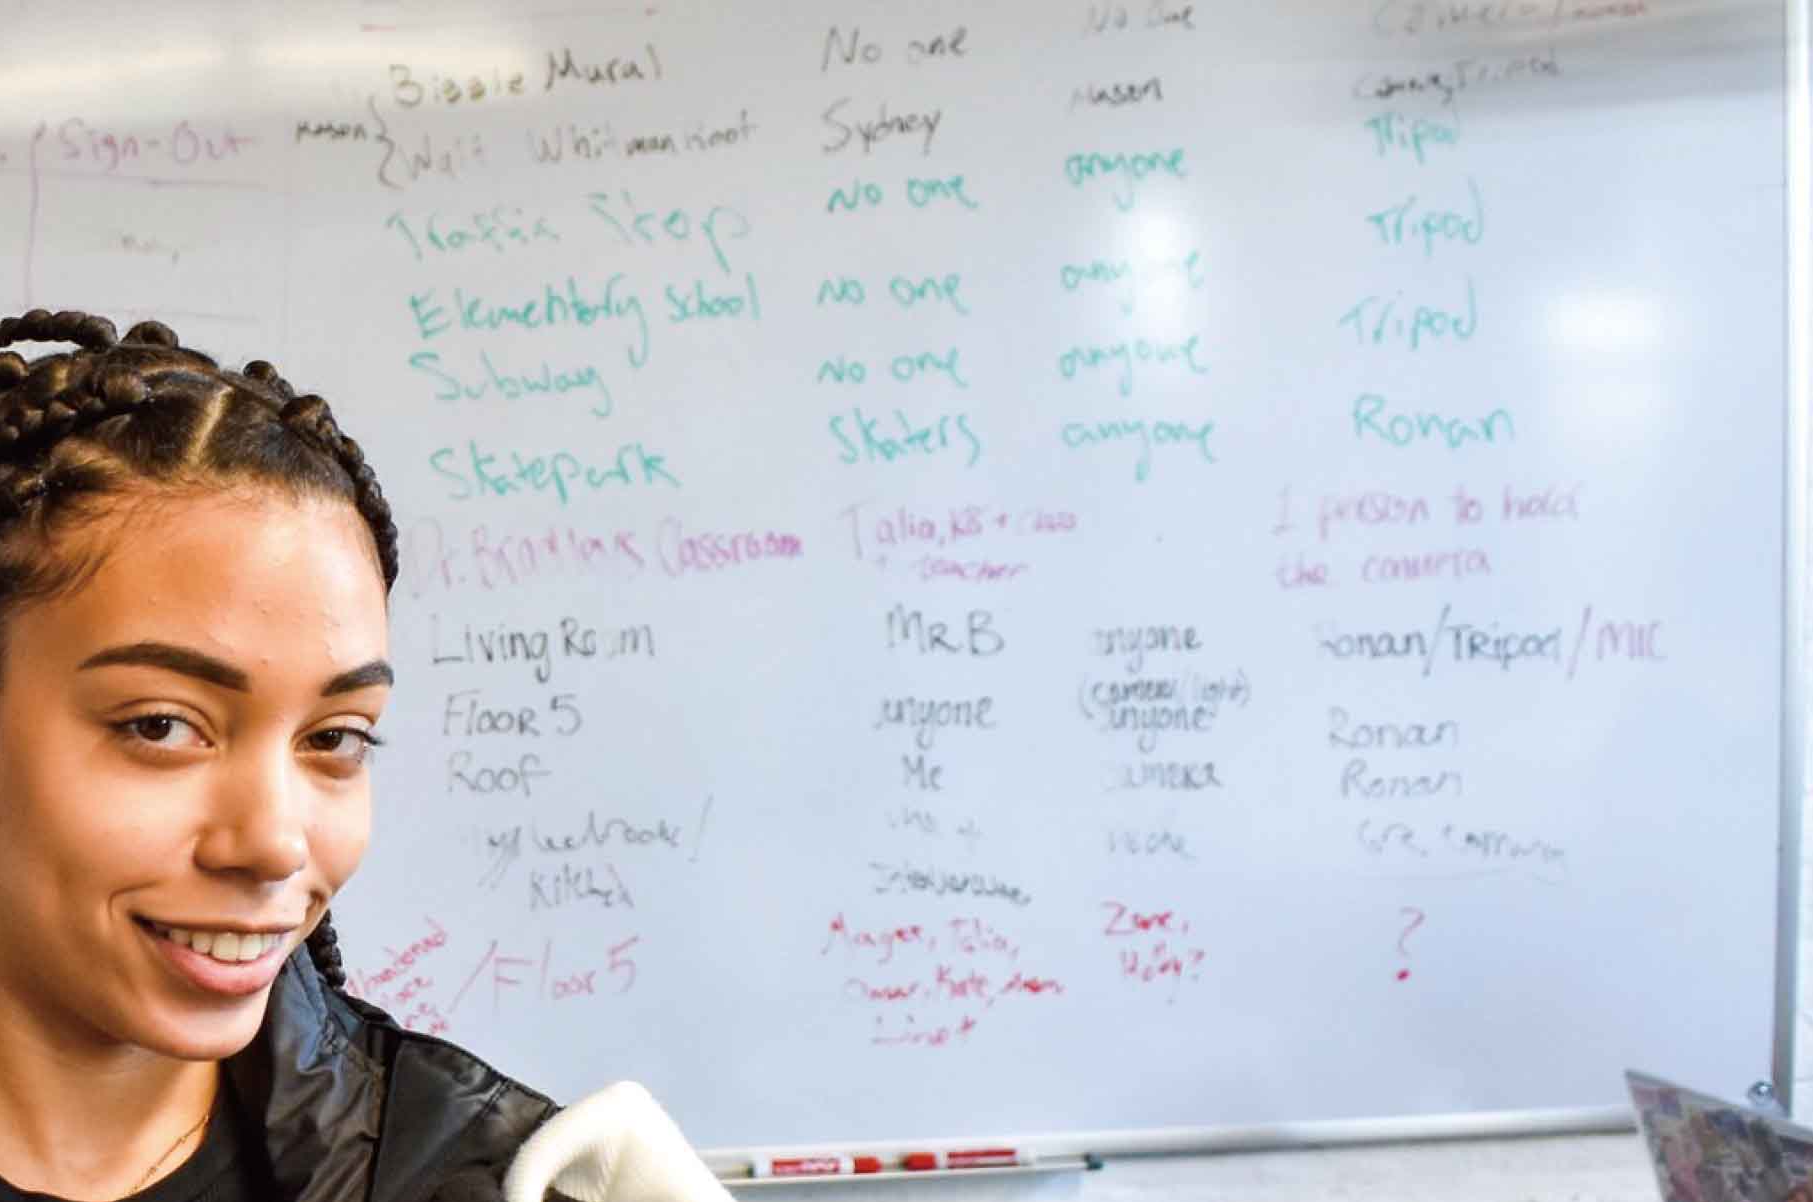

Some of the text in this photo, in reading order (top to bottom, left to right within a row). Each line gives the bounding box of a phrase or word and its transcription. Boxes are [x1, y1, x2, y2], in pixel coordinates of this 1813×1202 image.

[821, 26, 969, 71] No one
[822, 98, 943, 155] Sydney
[826, 174, 979, 213] No one
[1064, 148, 1188, 212] anyone
[1367, 176, 1485, 258] Tripod
[817, 273, 970, 316] No one
[1338, 272, 1479, 352] Tripod
[408, 351, 613, 418] Subway
[817, 347, 970, 390] No one
[829, 406, 982, 468] Skaters
[1352, 391, 1516, 451] Ronan
[1060, 418, 1217, 483] anyone
[550, 693, 583, 737] 5
[1327, 704, 1460, 750] Ronan
[445, 750, 552, 798] Roof
[1340, 757, 1464, 799] Ronan
[606, 936, 642, 993] 5
